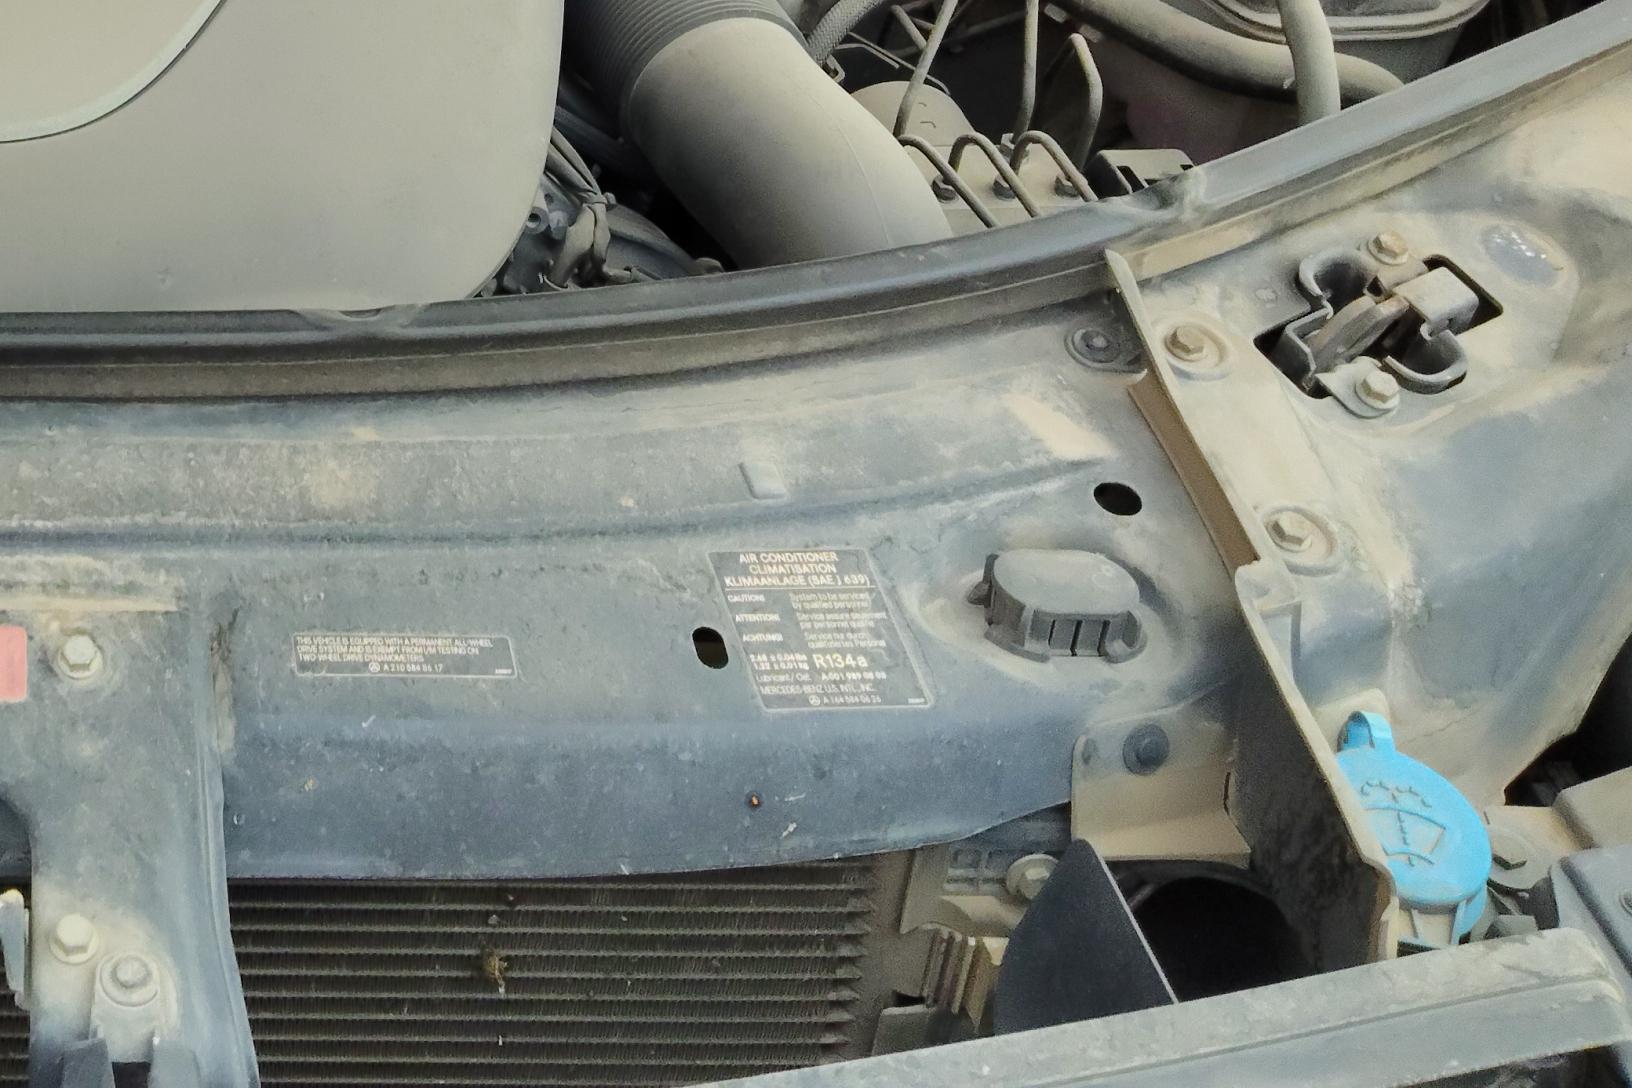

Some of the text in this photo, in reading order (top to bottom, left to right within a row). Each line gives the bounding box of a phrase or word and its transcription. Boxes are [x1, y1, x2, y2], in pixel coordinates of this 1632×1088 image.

[739, 552, 839, 563] AIR CONDITIONER
[749, 563, 837, 574] CLIMATISATION
[724, 576, 806, 587] KLIMAANLAGE
[808, 575, 834, 587] (SAE
[812, 654, 868, 669] R134a
